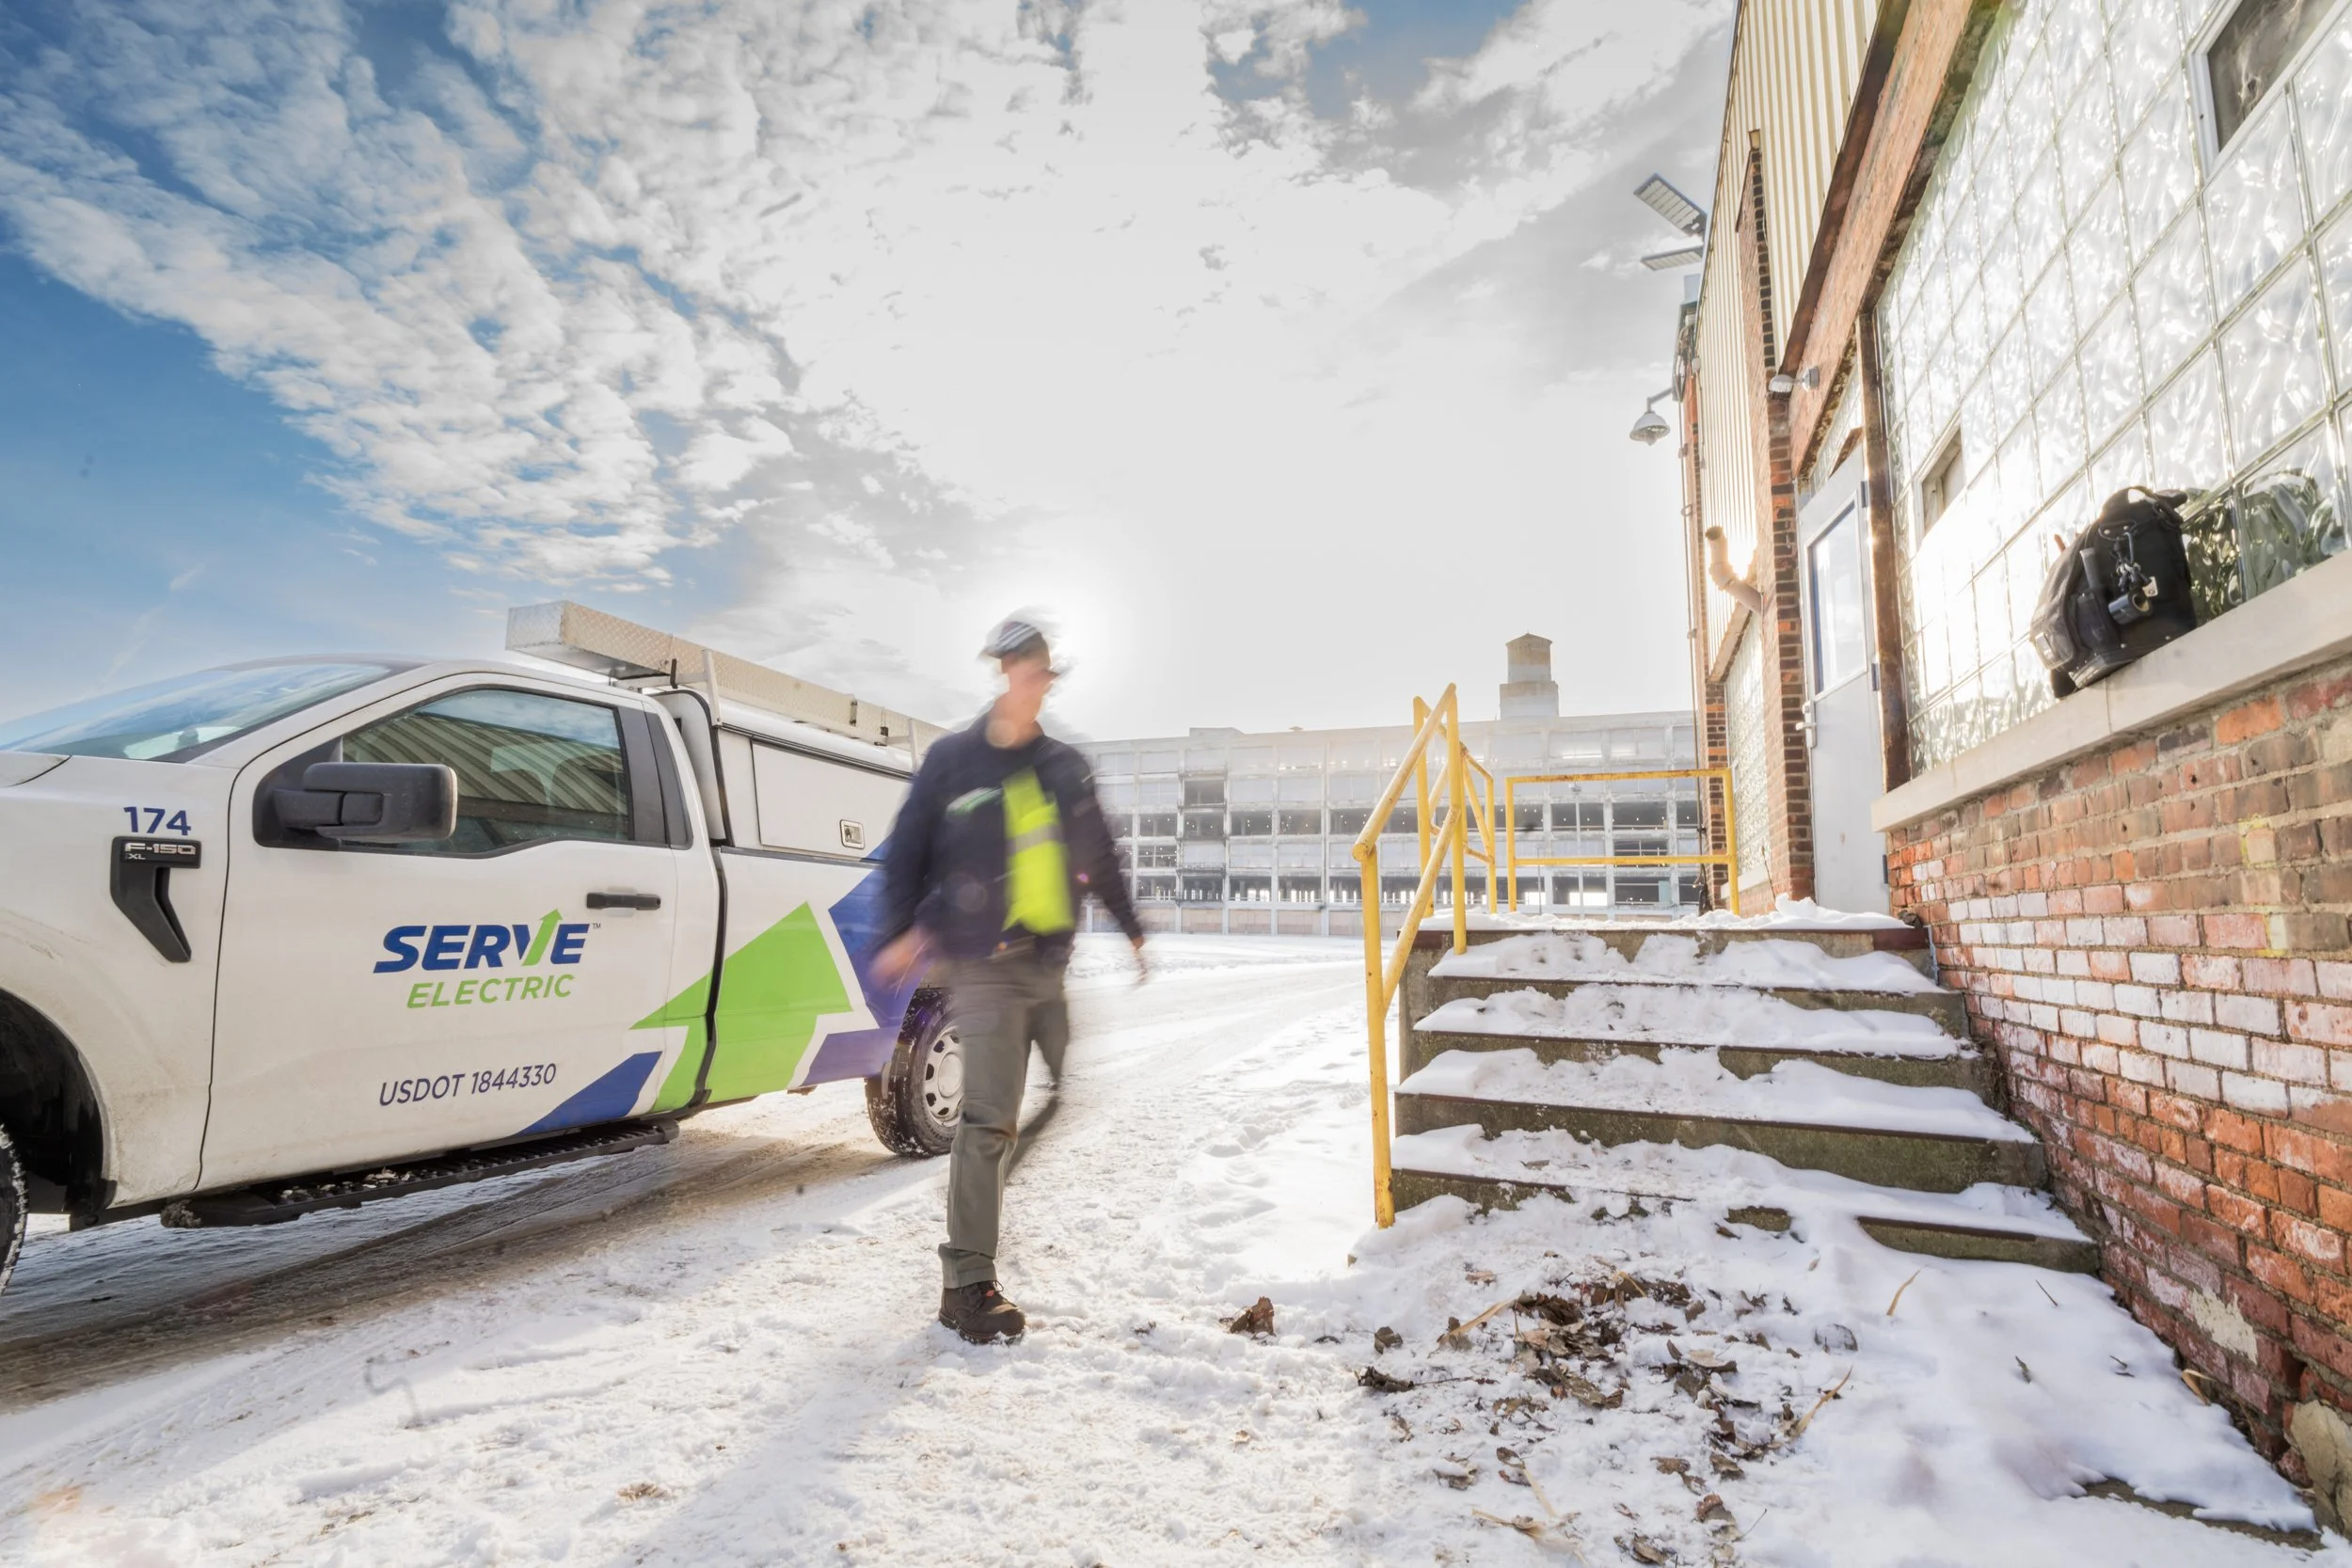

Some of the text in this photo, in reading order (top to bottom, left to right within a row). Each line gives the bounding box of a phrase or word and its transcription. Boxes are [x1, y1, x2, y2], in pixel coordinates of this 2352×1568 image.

[123, 806, 192, 836] 174
[124, 842, 197, 855] F-150
[373, 909, 590, 974] SERVE
[406, 974, 576, 1008] ELECTRIC
[379, 1063, 557, 1106] USDOT 1844330
